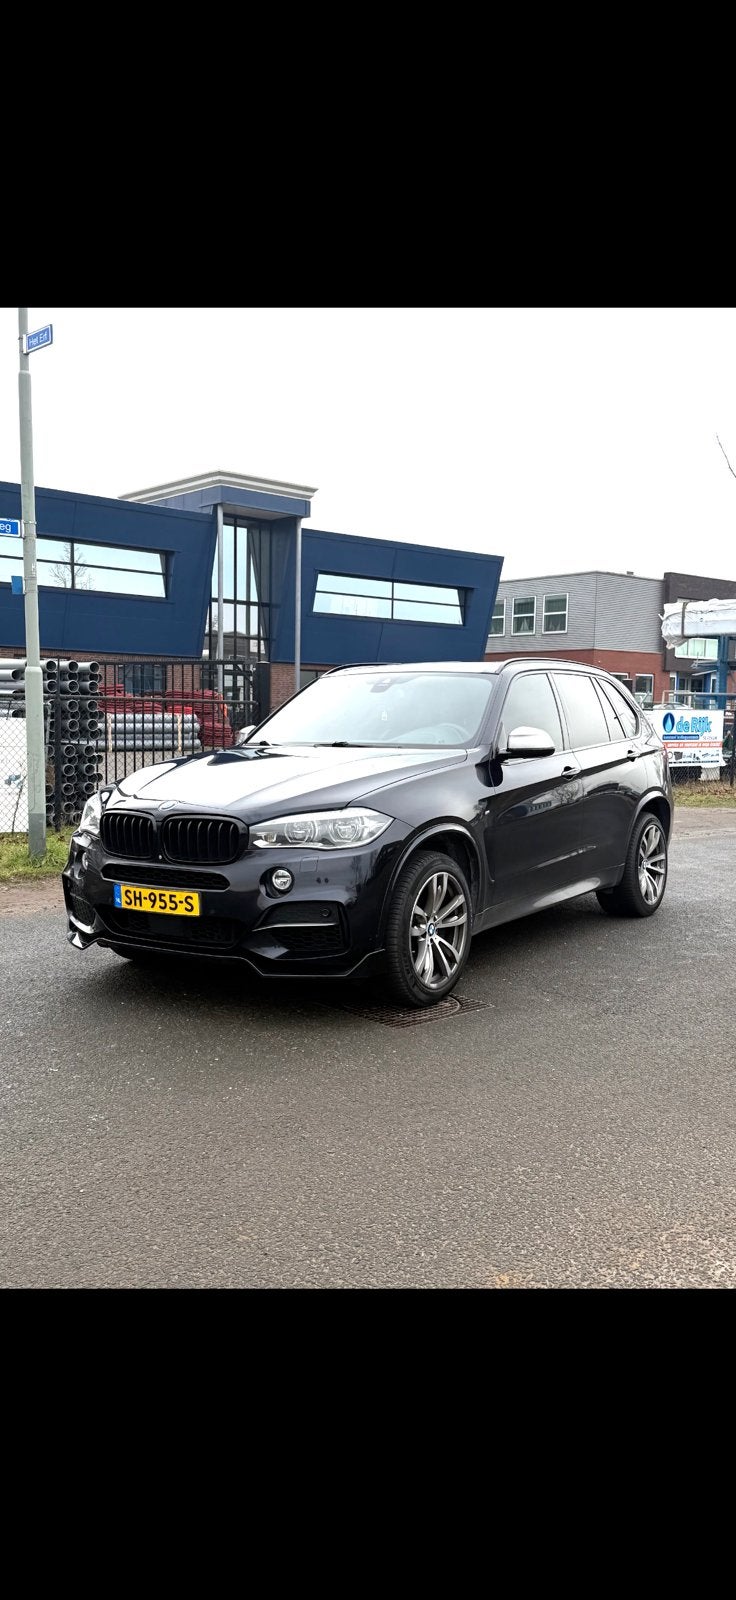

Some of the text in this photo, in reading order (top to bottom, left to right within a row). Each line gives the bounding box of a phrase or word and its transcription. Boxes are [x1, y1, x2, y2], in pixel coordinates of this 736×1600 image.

[676, 716, 712, 736] de Rijk
[125, 889, 194, 913] SH-955-S
